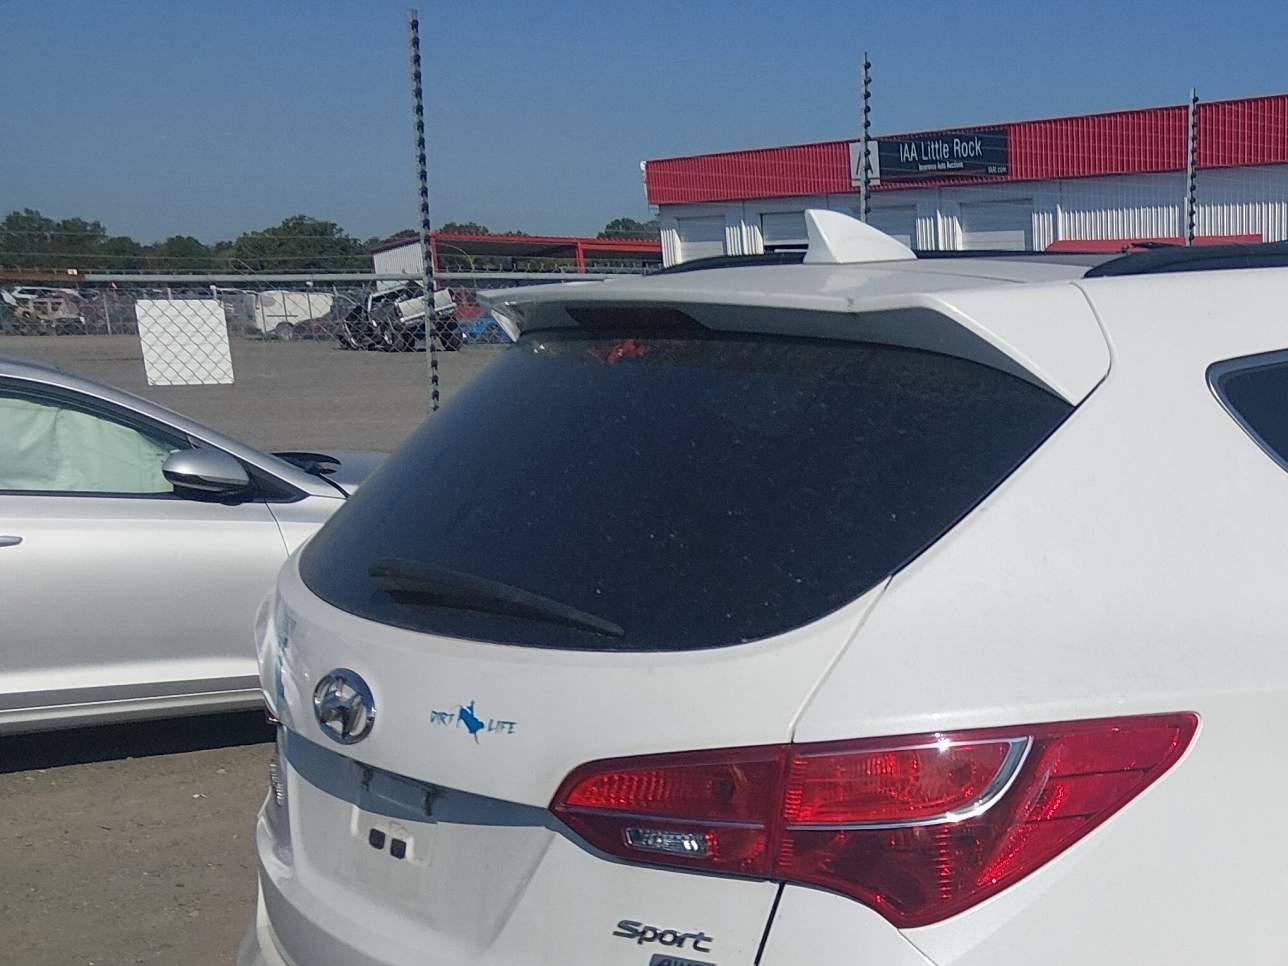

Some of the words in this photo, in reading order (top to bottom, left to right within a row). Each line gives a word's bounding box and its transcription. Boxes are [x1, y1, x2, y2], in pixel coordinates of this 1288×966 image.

[900, 143, 918, 163] IAA
[921, 140, 950, 161] Little
[953, 136, 983, 158] Rock
[486, 718, 519, 735] LIFE
[612, 919, 714, 953] Sport
